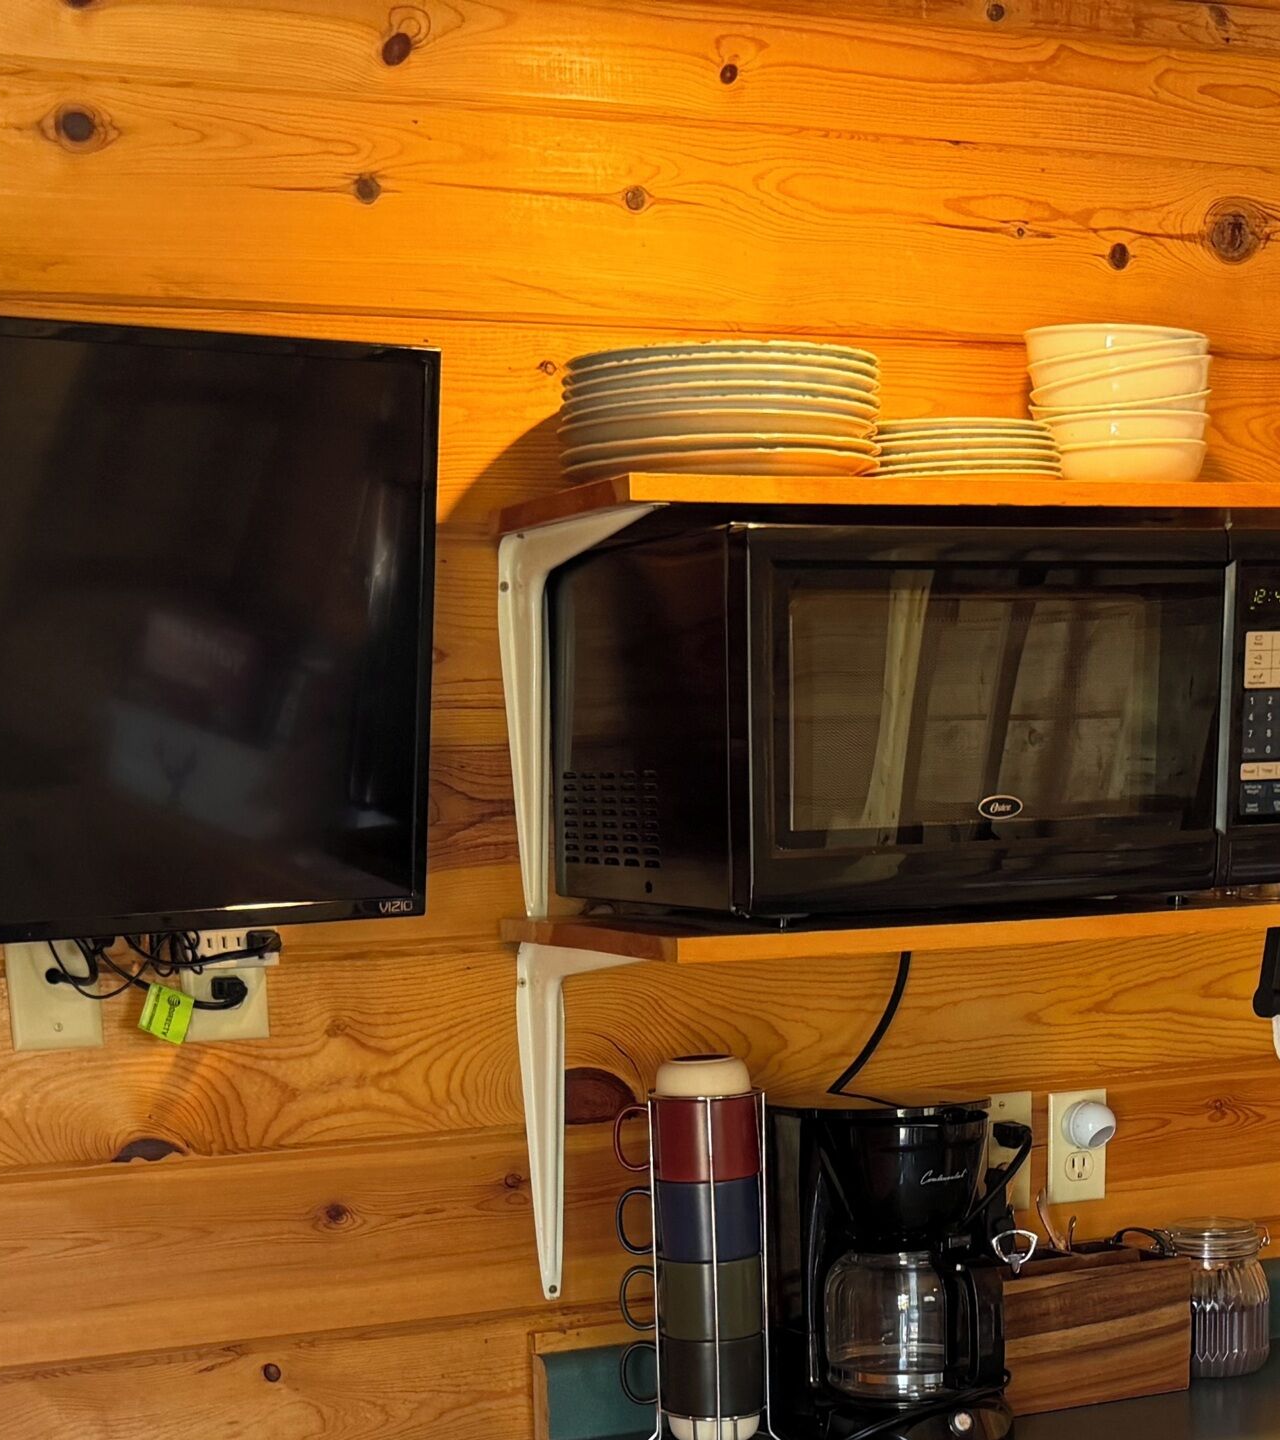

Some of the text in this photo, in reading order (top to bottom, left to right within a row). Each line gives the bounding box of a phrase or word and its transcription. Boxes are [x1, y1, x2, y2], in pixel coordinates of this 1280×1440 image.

[1267, 695, 1273, 705] 2
[1248, 712, 1254, 721] 4
[1266, 711, 1272, 721] 5
[1248, 729, 1254, 738] 7
[1266, 728, 1272, 738] 8
[1265, 744, 1271, 754] 0
[378, 900, 414, 913] VIZIO
